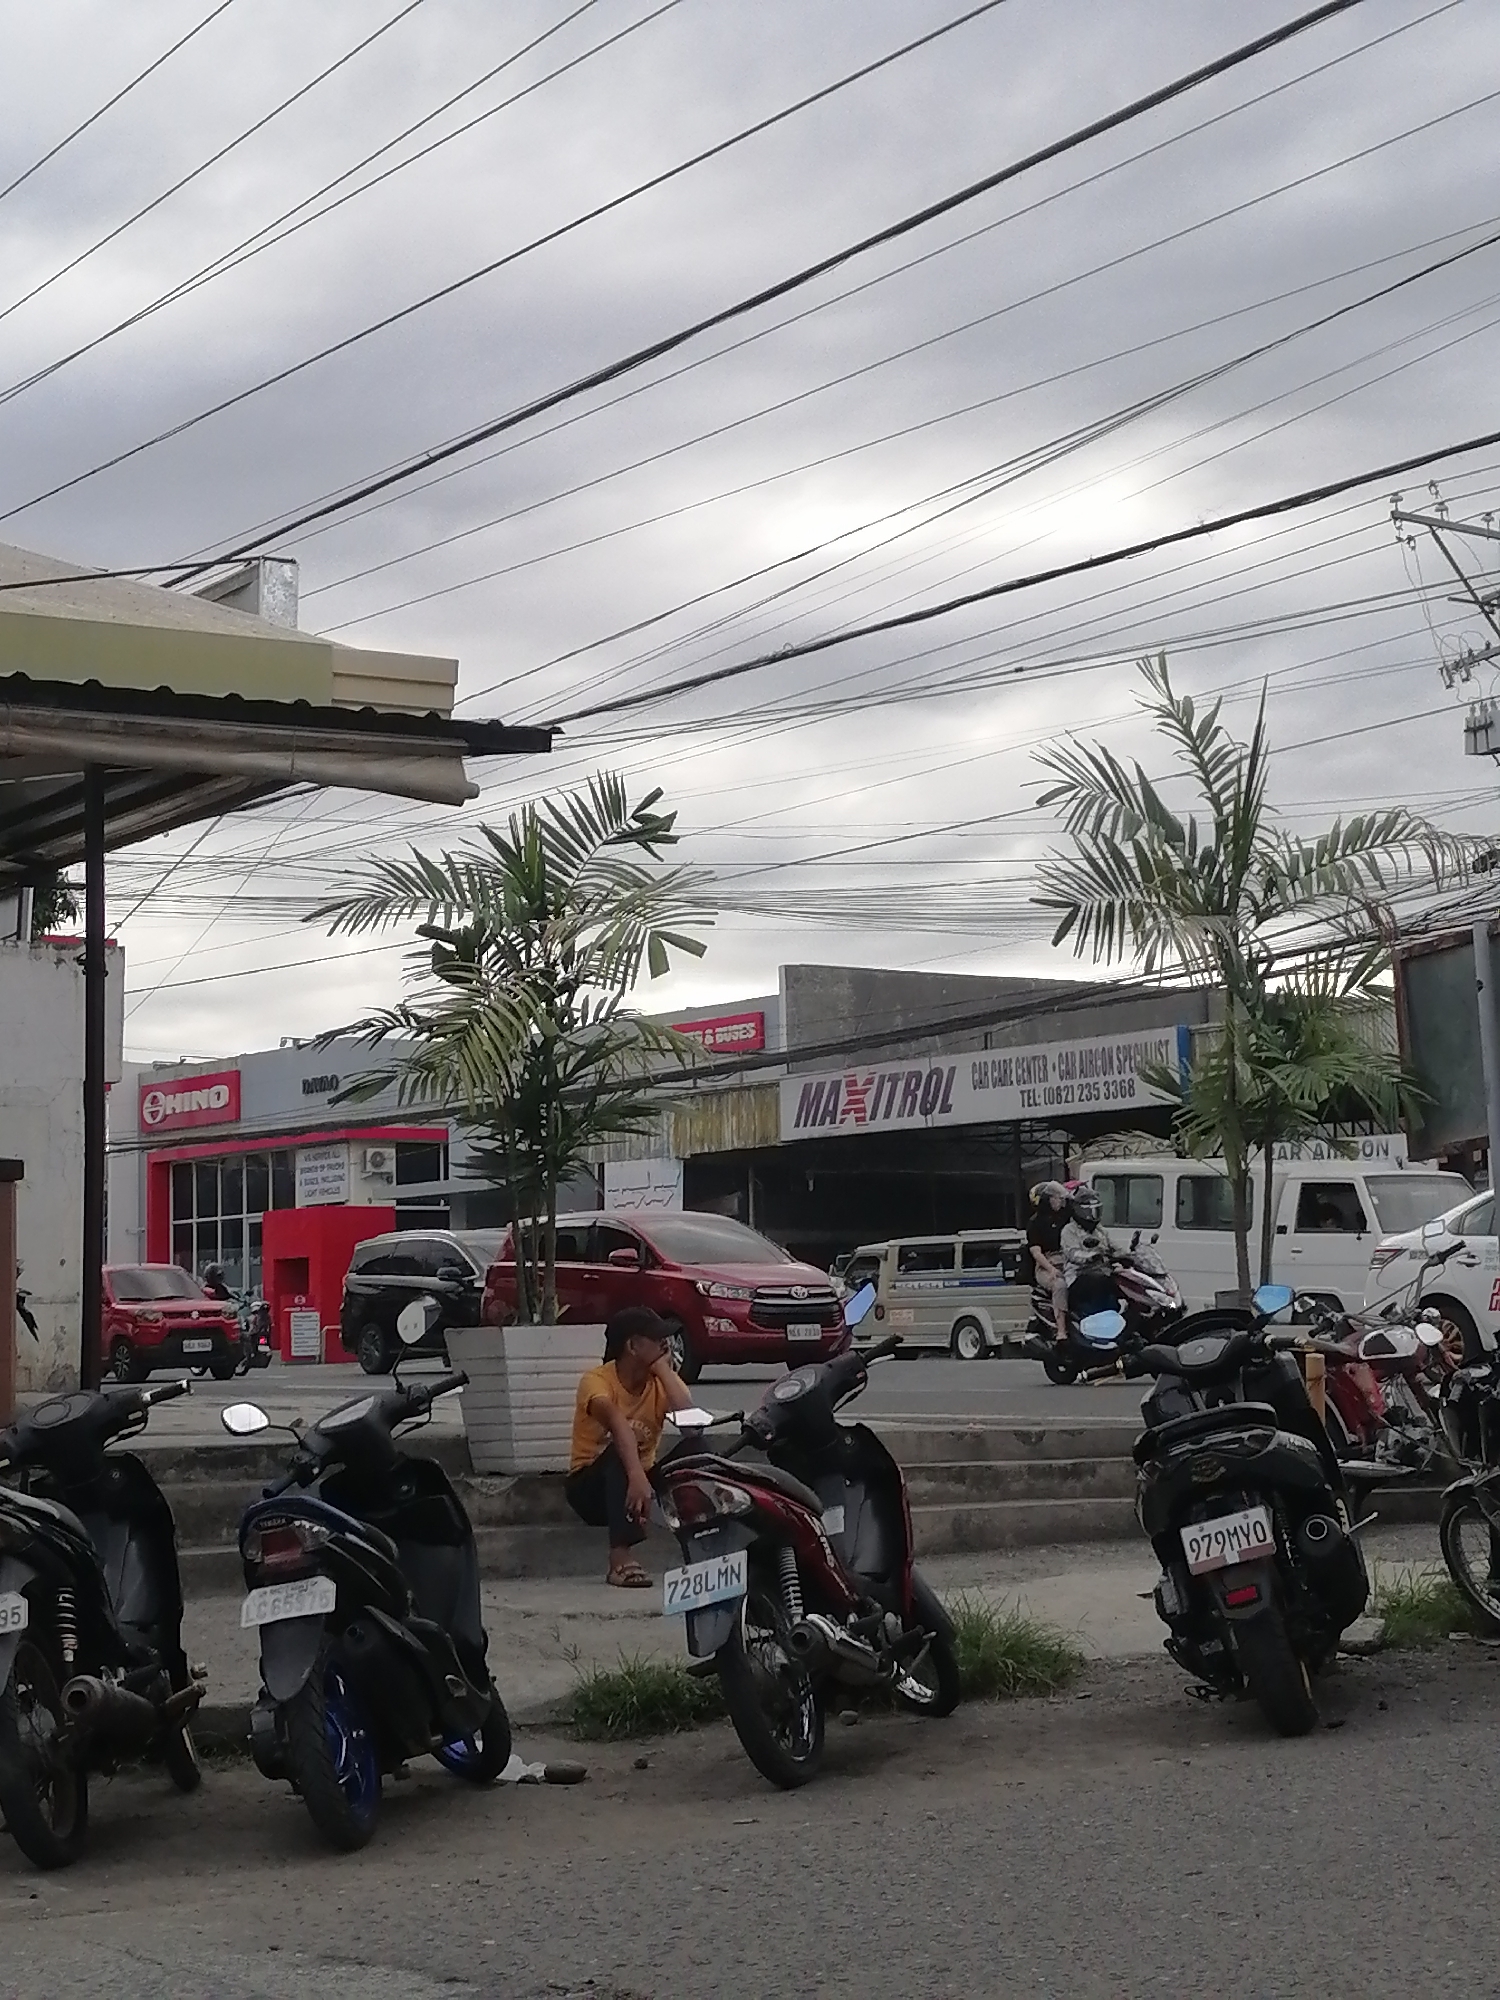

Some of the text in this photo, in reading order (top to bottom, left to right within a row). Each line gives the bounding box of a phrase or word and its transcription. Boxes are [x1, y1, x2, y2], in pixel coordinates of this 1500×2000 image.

[715, 1023, 756, 1044] BUSES
[971, 1057, 989, 1090] CAR
[991, 1055, 1014, 1087] CARE
[1015, 1054, 1049, 1085] CENTER
[1057, 1050, 1077, 1081] CAR
[1079, 1046, 1115, 1079] AIRCON
[165, 1085, 230, 1116] HINO
[793, 1065, 958, 1128] MAXITROL
[1077, 1080, 1100, 1104] 235
[1103, 1077, 1136, 1101] 3368
[1271, 1139, 1390, 1161] AR AION
[667, 1561, 742, 1605] 728LMN
